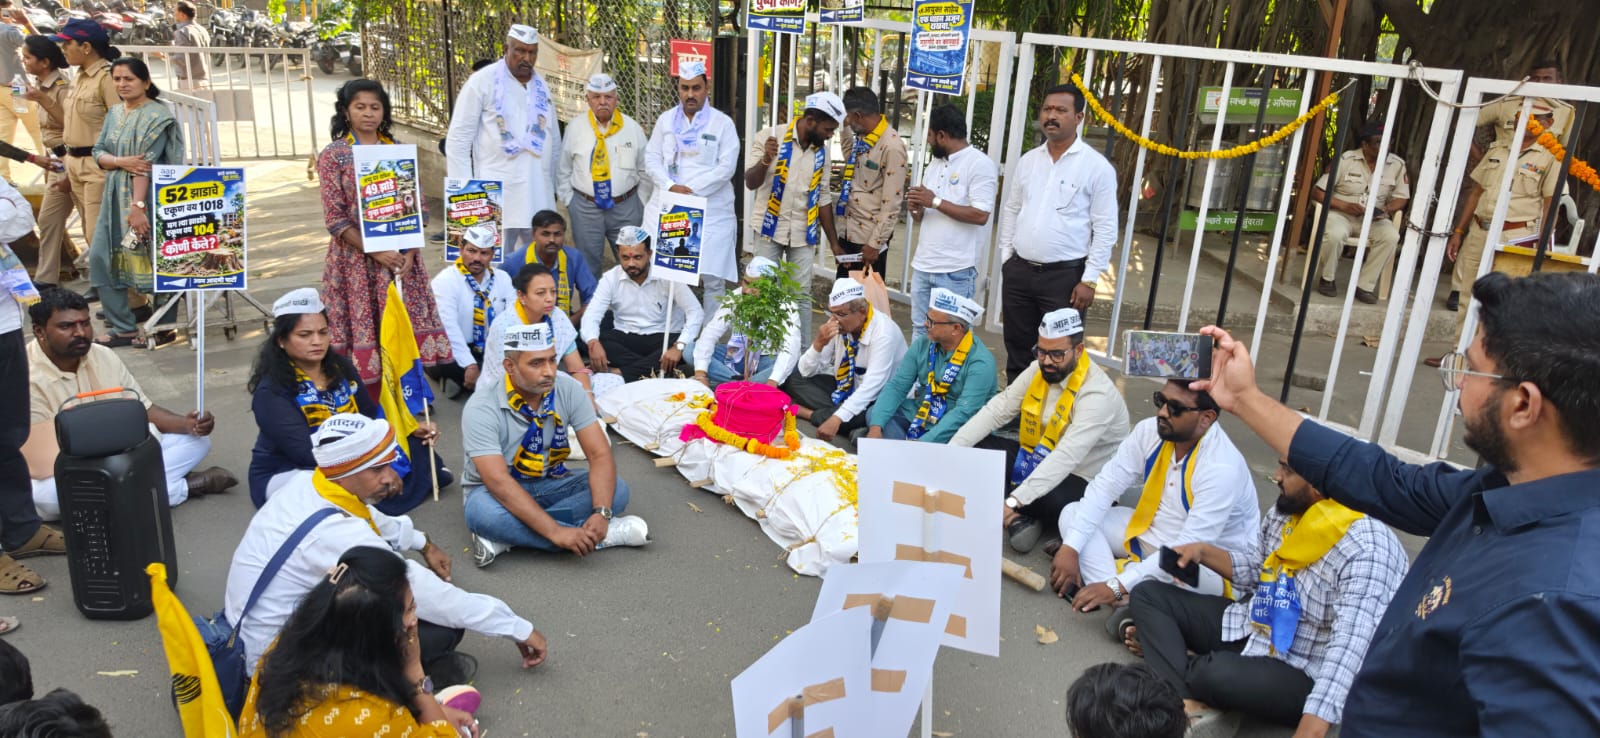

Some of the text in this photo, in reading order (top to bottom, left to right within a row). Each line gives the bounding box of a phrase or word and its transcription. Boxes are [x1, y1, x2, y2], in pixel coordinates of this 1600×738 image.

[1272, 96, 1296, 108] अभियान
[166, 184, 218, 203] 52 झाडाचे
[365, 183, 378, 195] 49
[164, 206, 184, 217] एकूण
[199, 199, 223, 211] 1018
[166, 228, 182, 239] एकूण
[193, 223, 214, 235] 104
[165, 239, 190, 254] कोणी
[521, 329, 541, 341] पार्टी
[327, 418, 365, 430] आदमी
